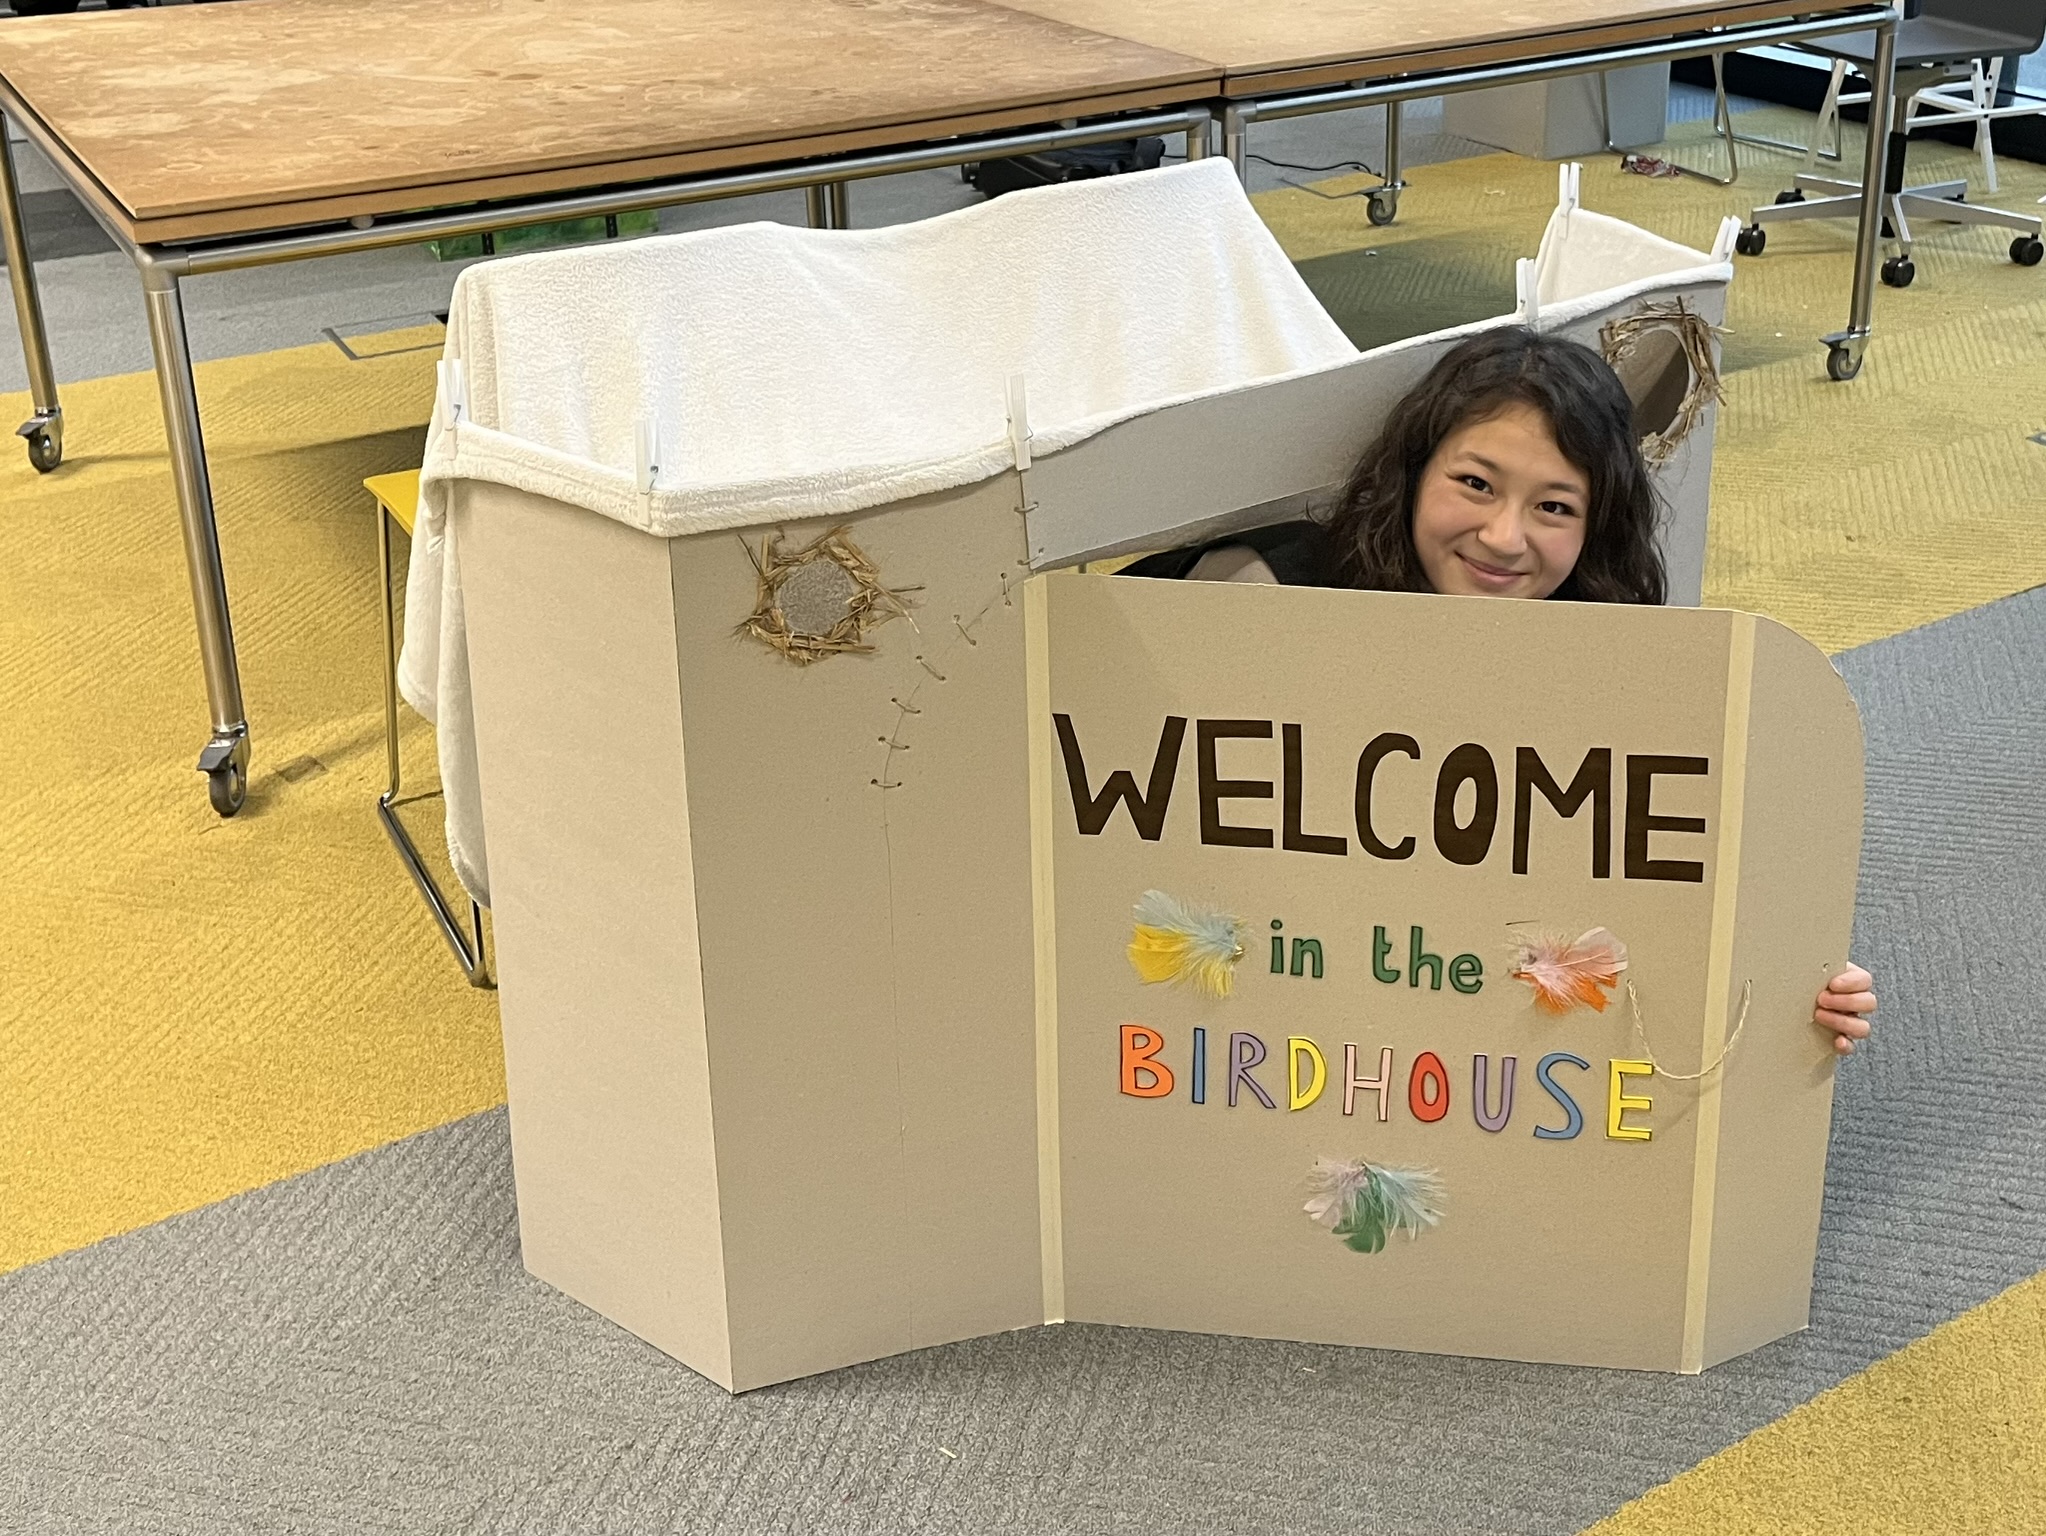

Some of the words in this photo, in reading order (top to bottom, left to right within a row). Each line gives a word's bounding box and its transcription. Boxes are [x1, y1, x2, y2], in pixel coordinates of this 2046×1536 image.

[1053, 713, 1709, 882] WELCOME
[1270, 920, 1324, 978] in
[1372, 926, 1484, 994] the
[1119, 1024, 1655, 1141] BIRDHOUSE
